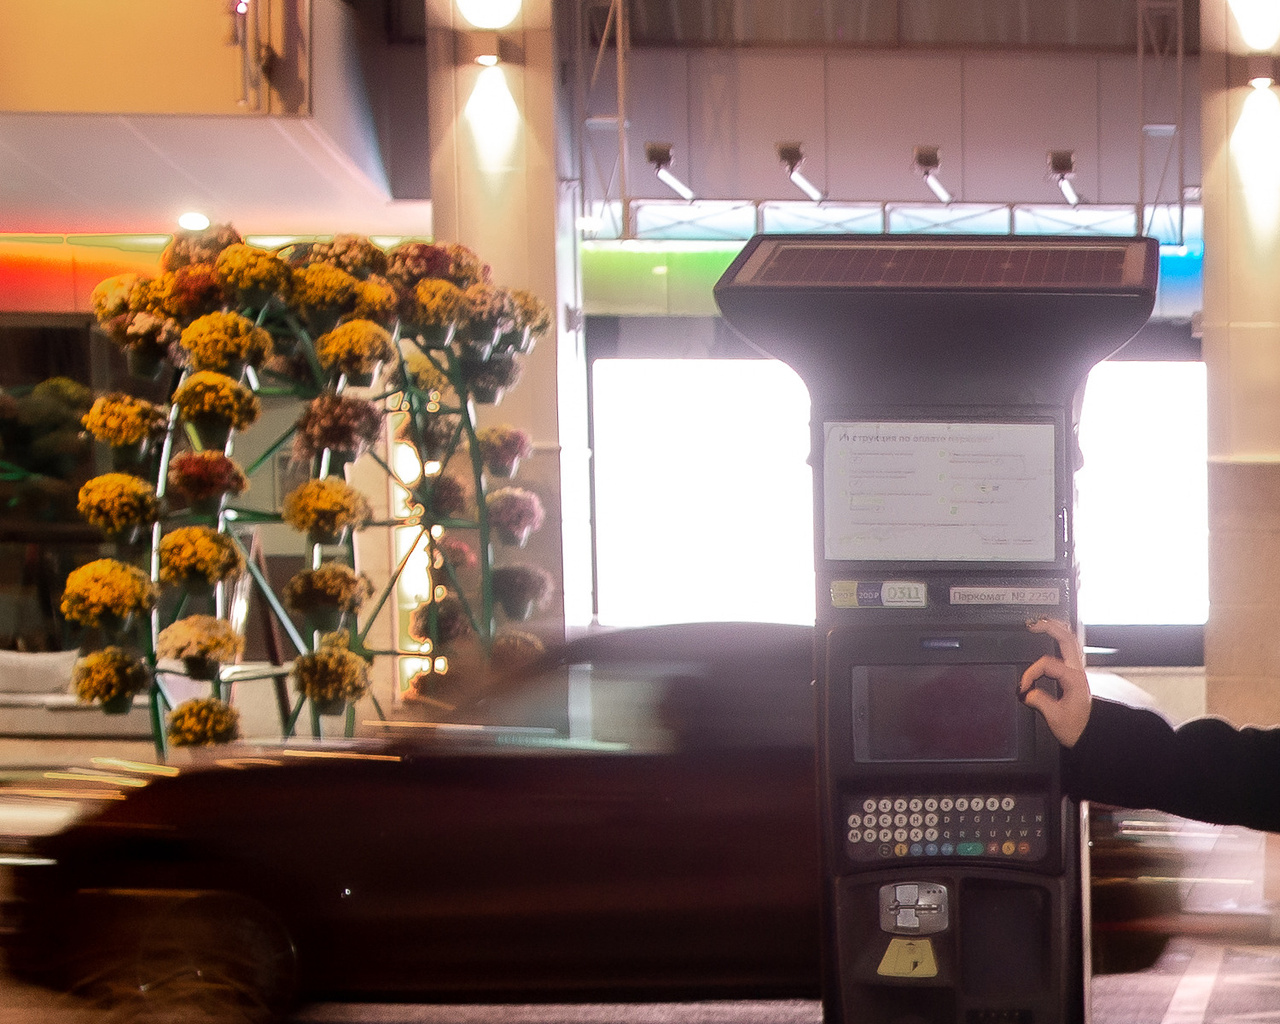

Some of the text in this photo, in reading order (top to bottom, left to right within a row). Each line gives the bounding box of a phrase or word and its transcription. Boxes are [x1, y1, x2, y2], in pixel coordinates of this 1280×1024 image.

[887, 586, 921, 599] 0311
[953, 591, 1006, 601] Паркомат
[1028, 592, 1056, 601] 2250
